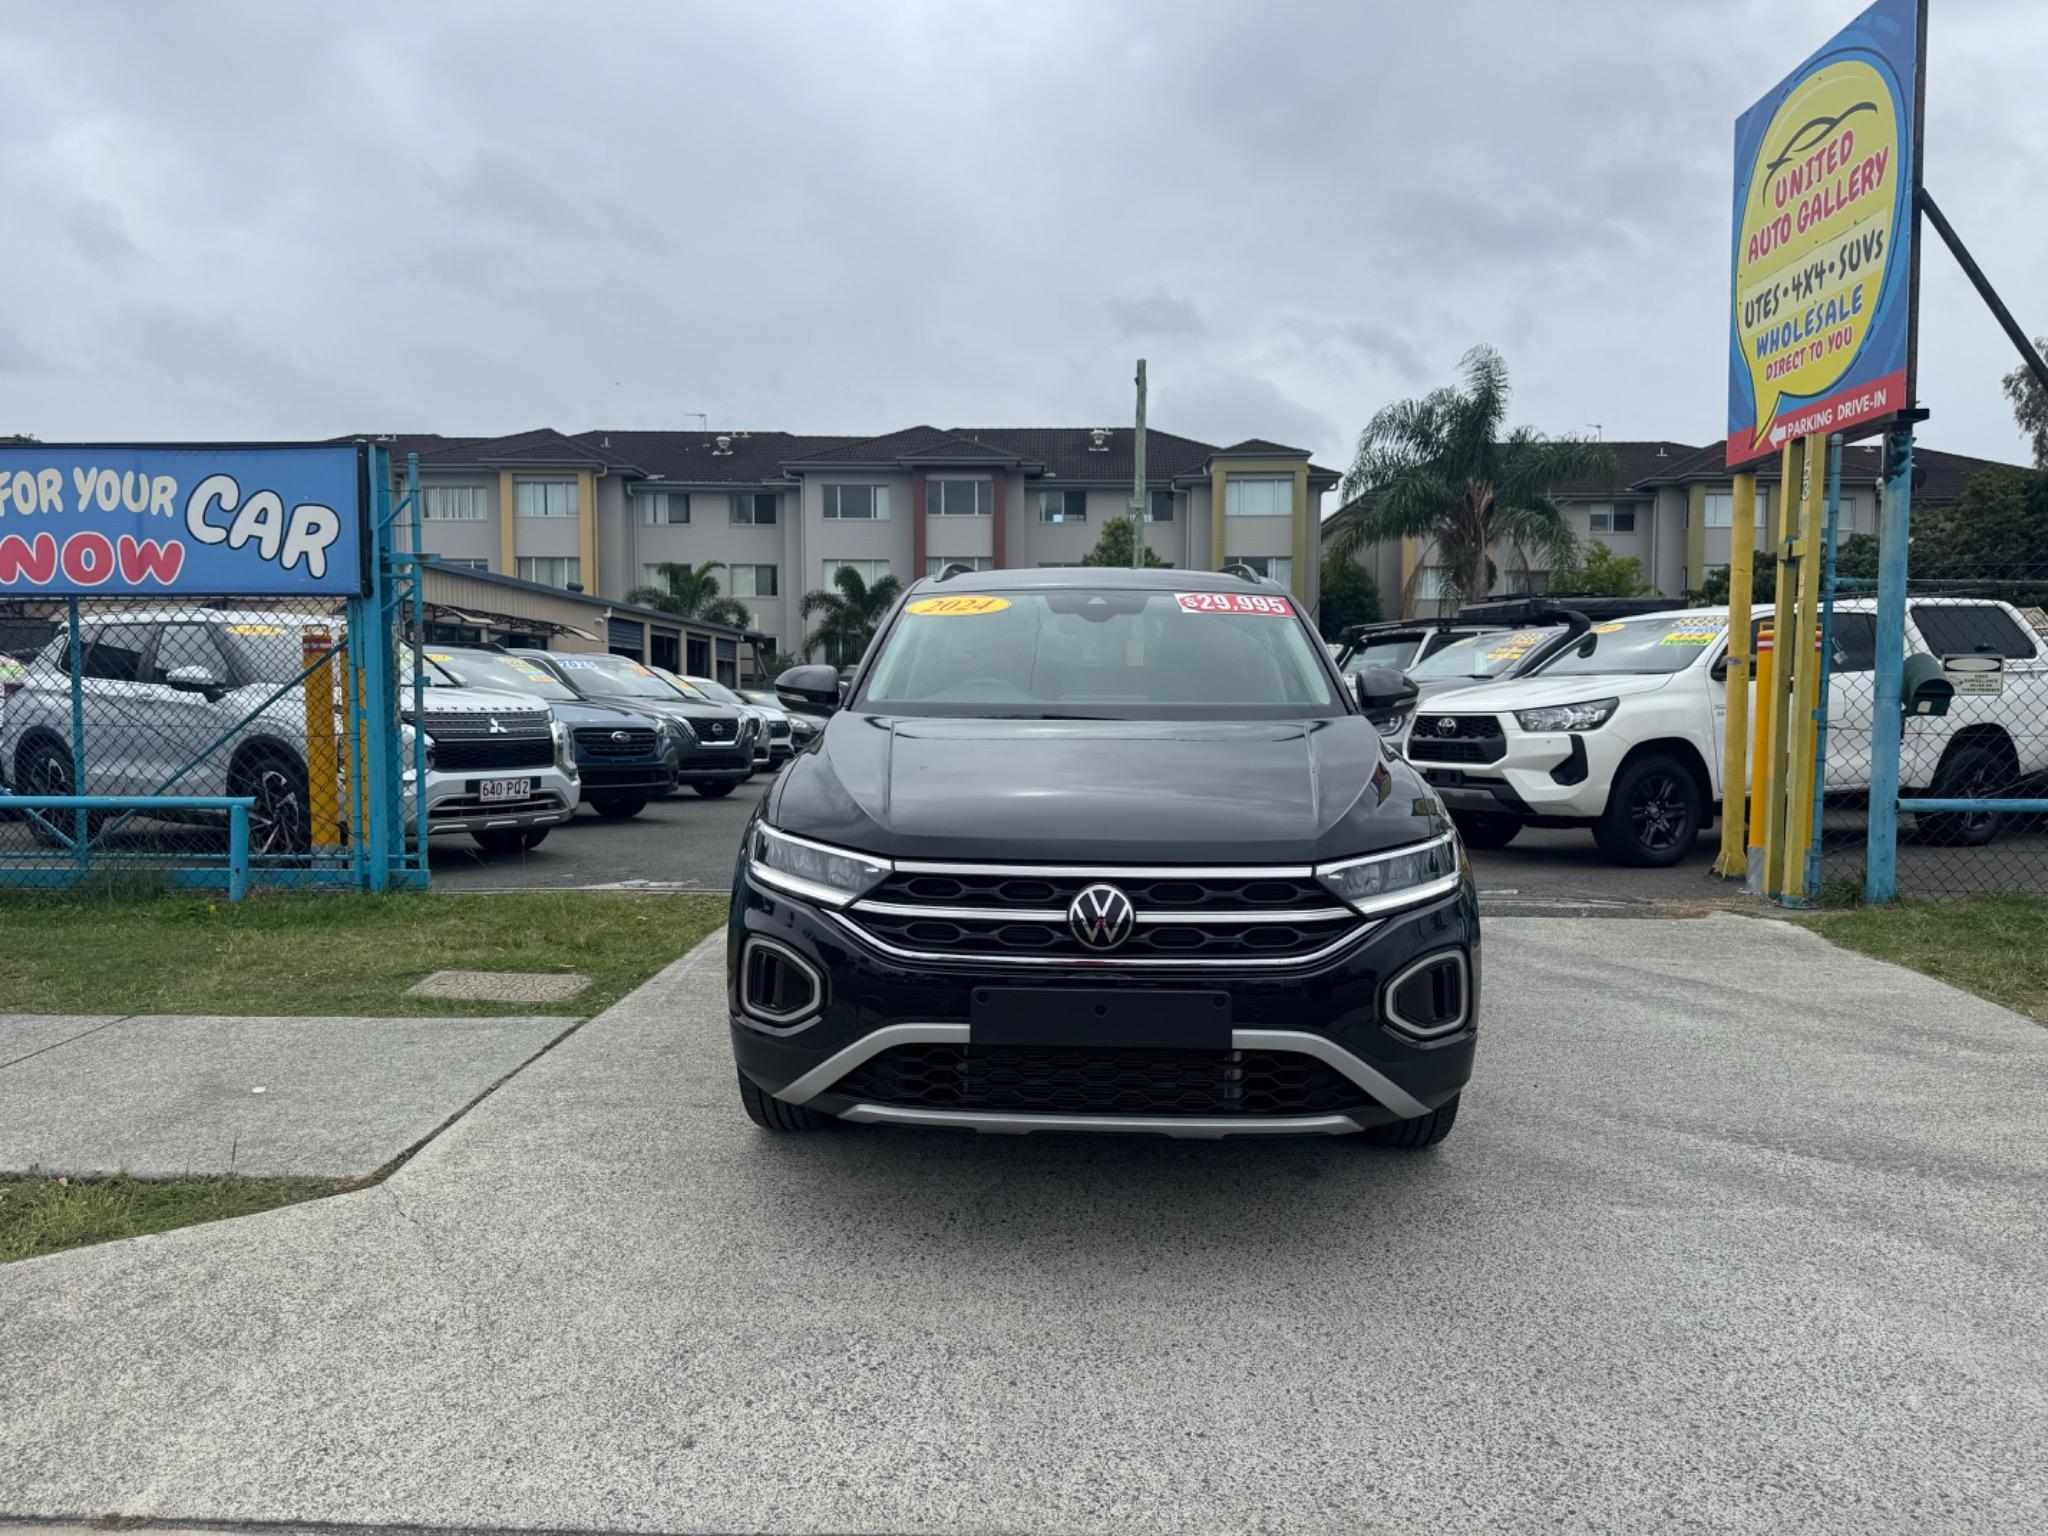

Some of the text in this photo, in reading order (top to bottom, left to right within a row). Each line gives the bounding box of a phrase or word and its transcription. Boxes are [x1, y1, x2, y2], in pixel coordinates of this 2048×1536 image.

[1747, 144, 1889, 265] AUTO GALLERY
[1774, 129, 1854, 209] UNITED
[1744, 228, 1885, 329] UTES 4X4 SUVS
[1756, 283, 1864, 359] WHOLESALE
[1765, 325, 1853, 382] DIRECT TO YOU
[1787, 388, 1887, 438] PARKING DRIVE-IN
[0, 466, 341, 580] FOR YOUR CAR
[0, 531, 185, 586] NOW
[482, 781, 503, 797] 640
